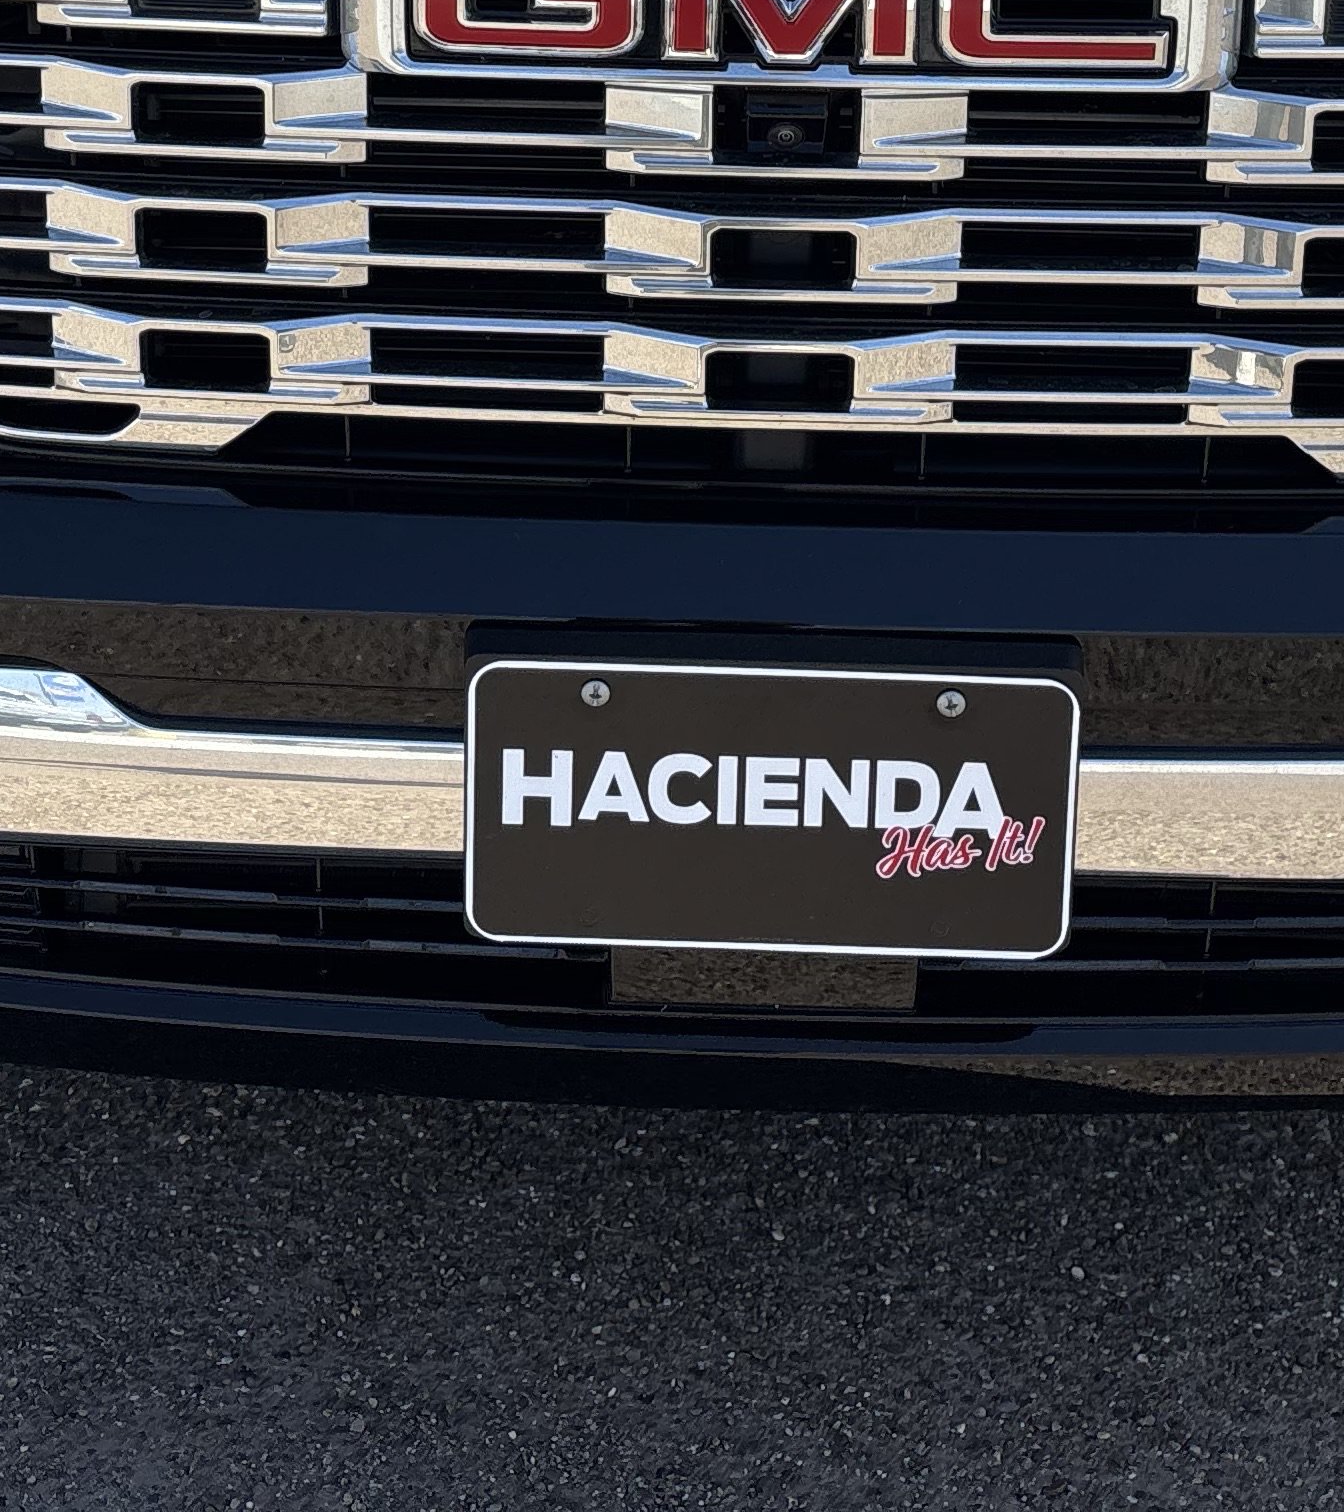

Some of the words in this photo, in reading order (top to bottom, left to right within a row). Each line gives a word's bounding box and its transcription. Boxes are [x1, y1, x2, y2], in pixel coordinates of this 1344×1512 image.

[501, 747, 1006, 839] HACIENDA
[875, 824, 983, 879] Has
[985, 815, 1046, 872] It!
